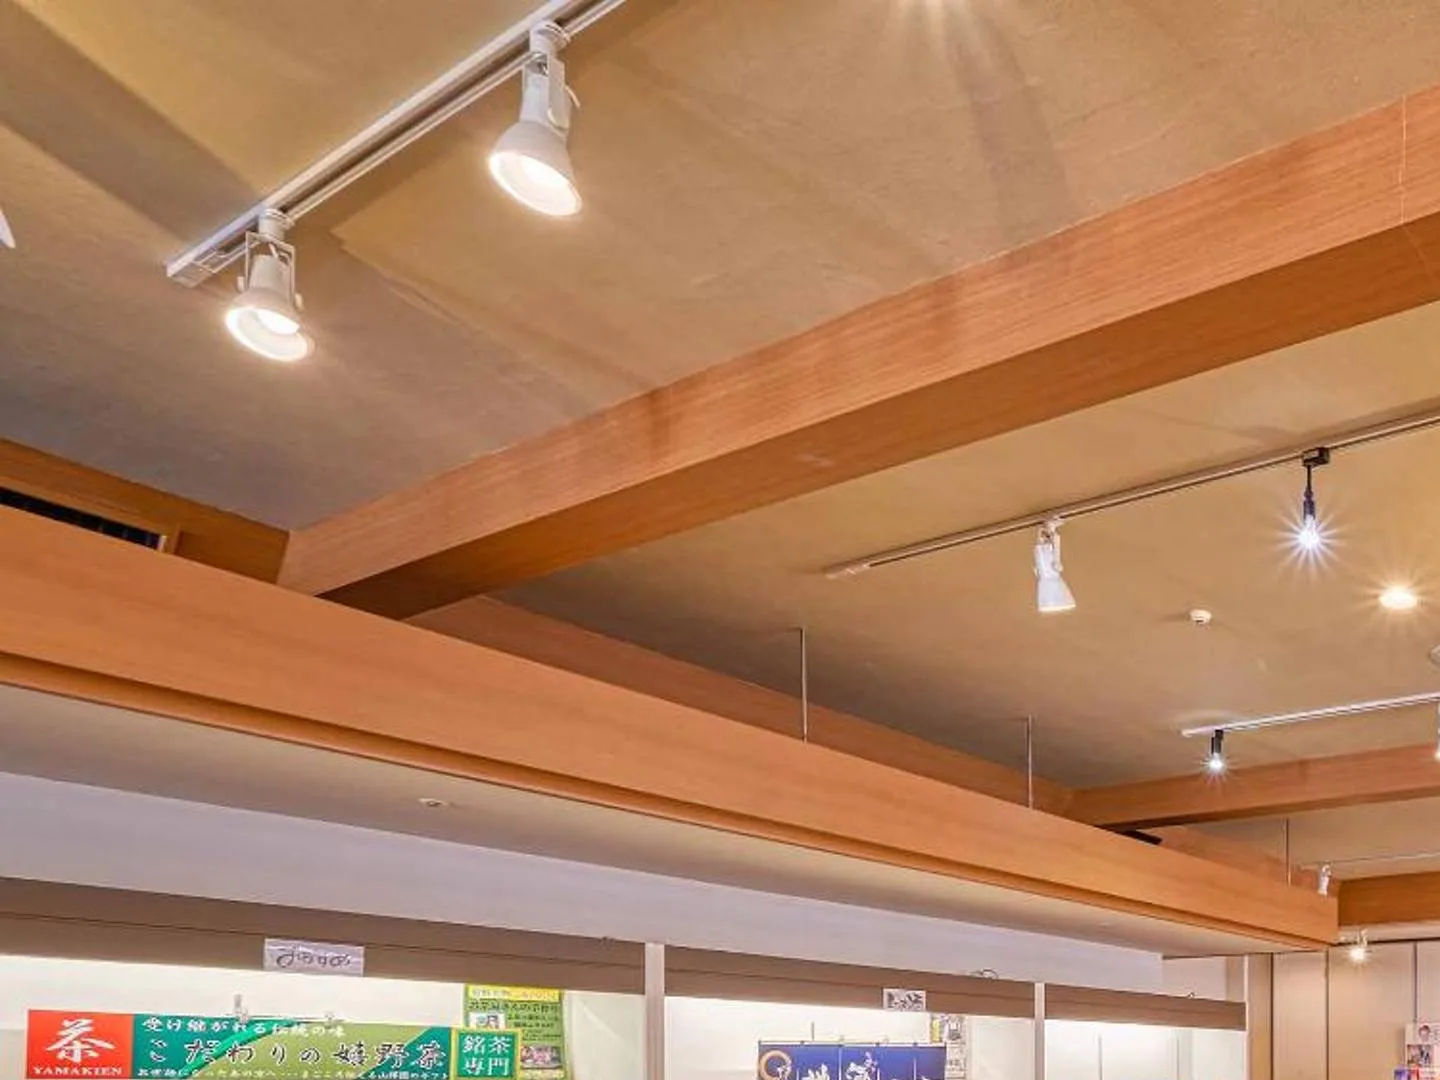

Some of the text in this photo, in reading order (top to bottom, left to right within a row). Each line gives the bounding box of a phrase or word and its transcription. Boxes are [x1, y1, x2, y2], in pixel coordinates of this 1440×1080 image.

[45, 1018, 117, 1063] 茶
[150, 1037, 447, 1070] こだわりの嬉野茶
[32, 1066, 123, 1076] YAMAKIEN
